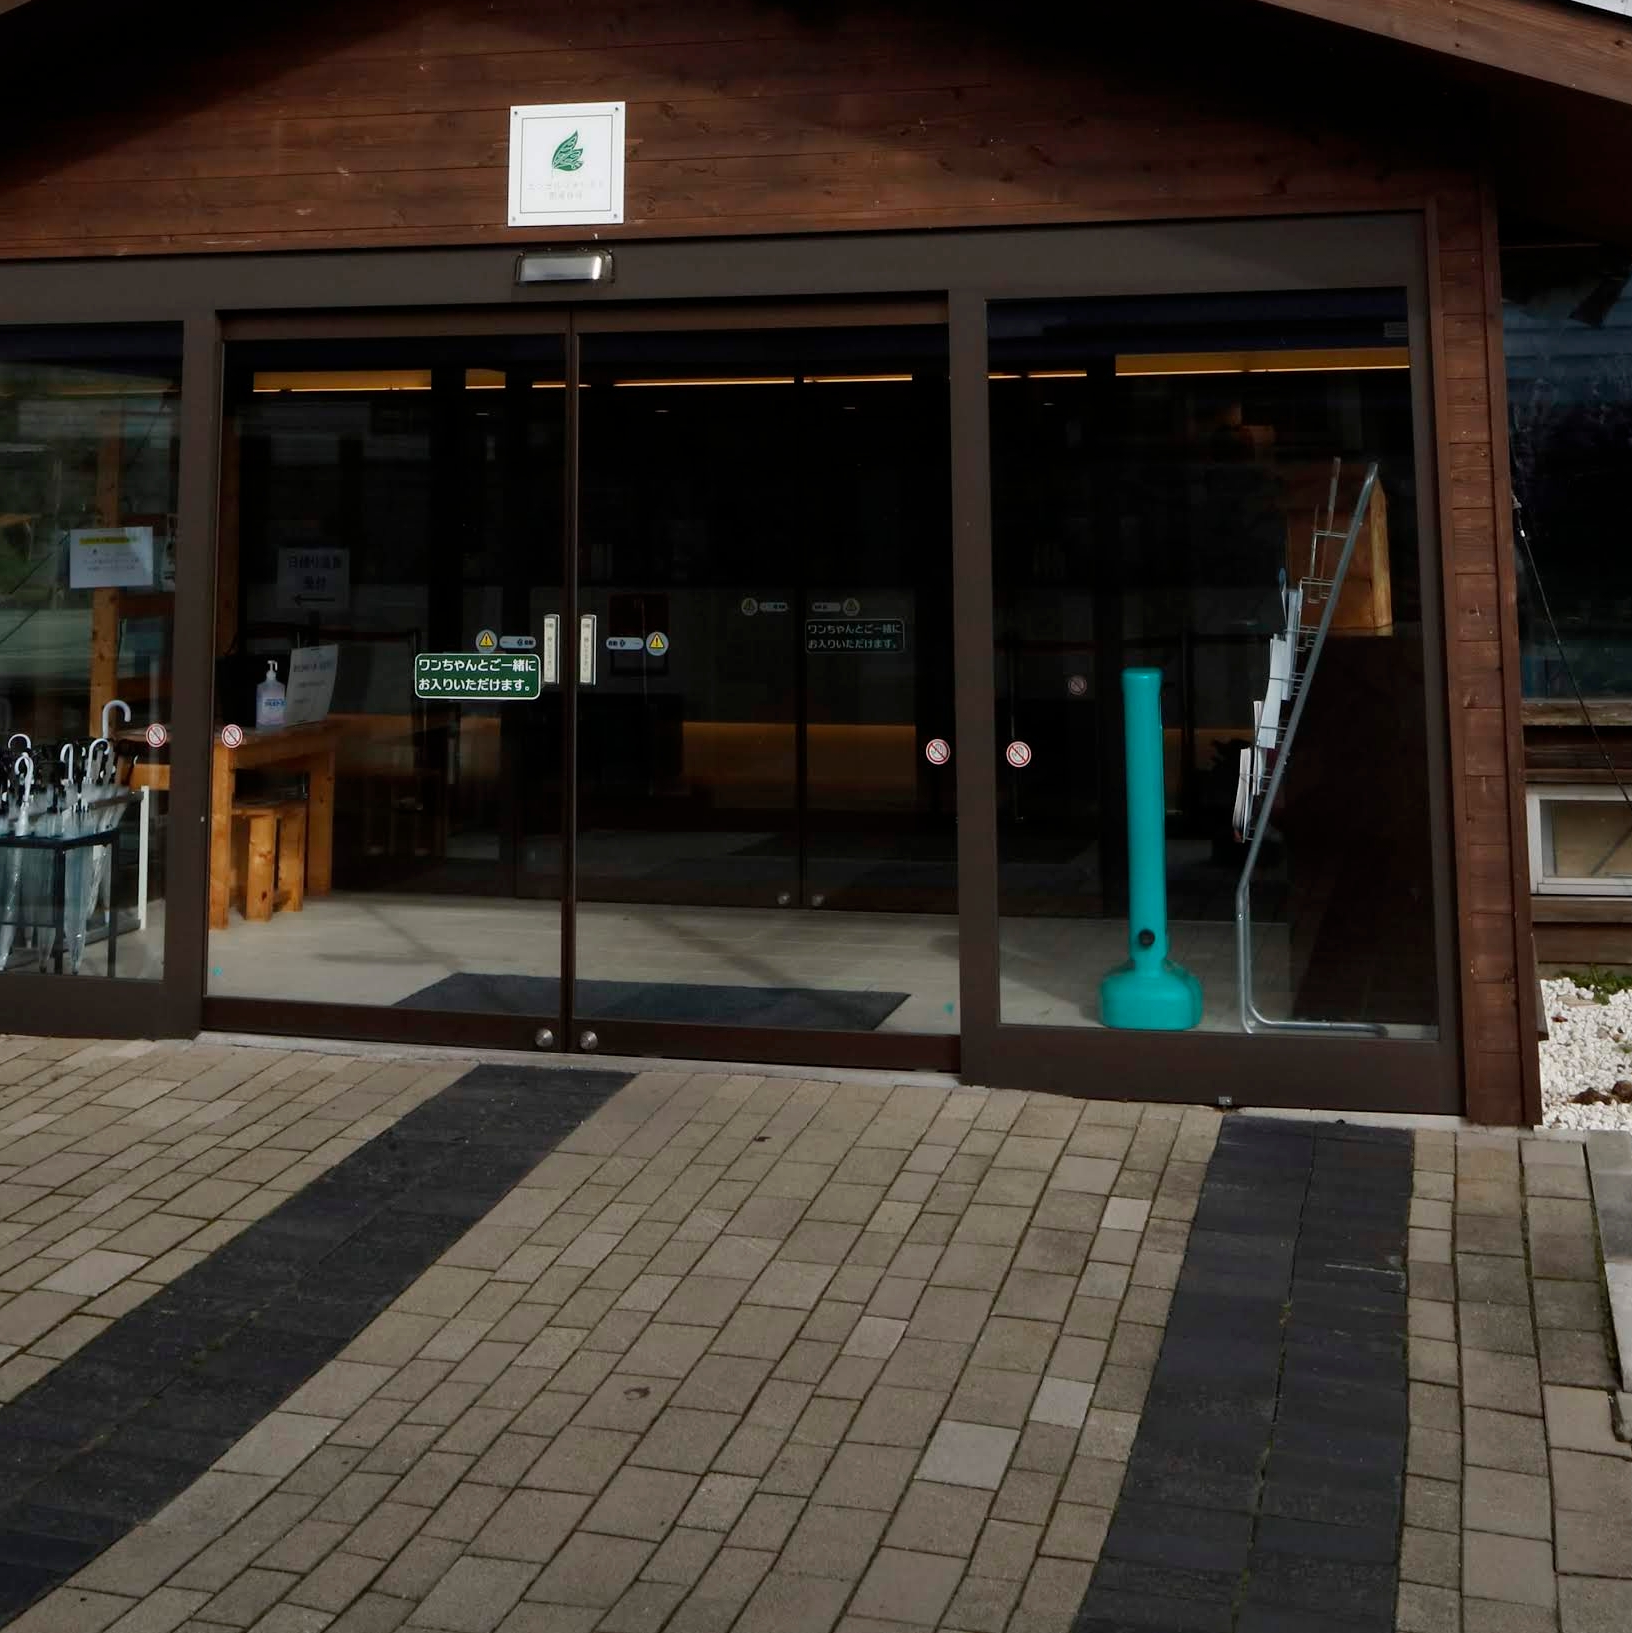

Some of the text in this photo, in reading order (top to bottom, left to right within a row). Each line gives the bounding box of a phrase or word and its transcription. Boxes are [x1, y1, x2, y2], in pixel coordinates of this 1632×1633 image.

[418, 658, 536, 672] ワンちゃんとご一緒に
[418, 678, 531, 692] お入りいただけます。
